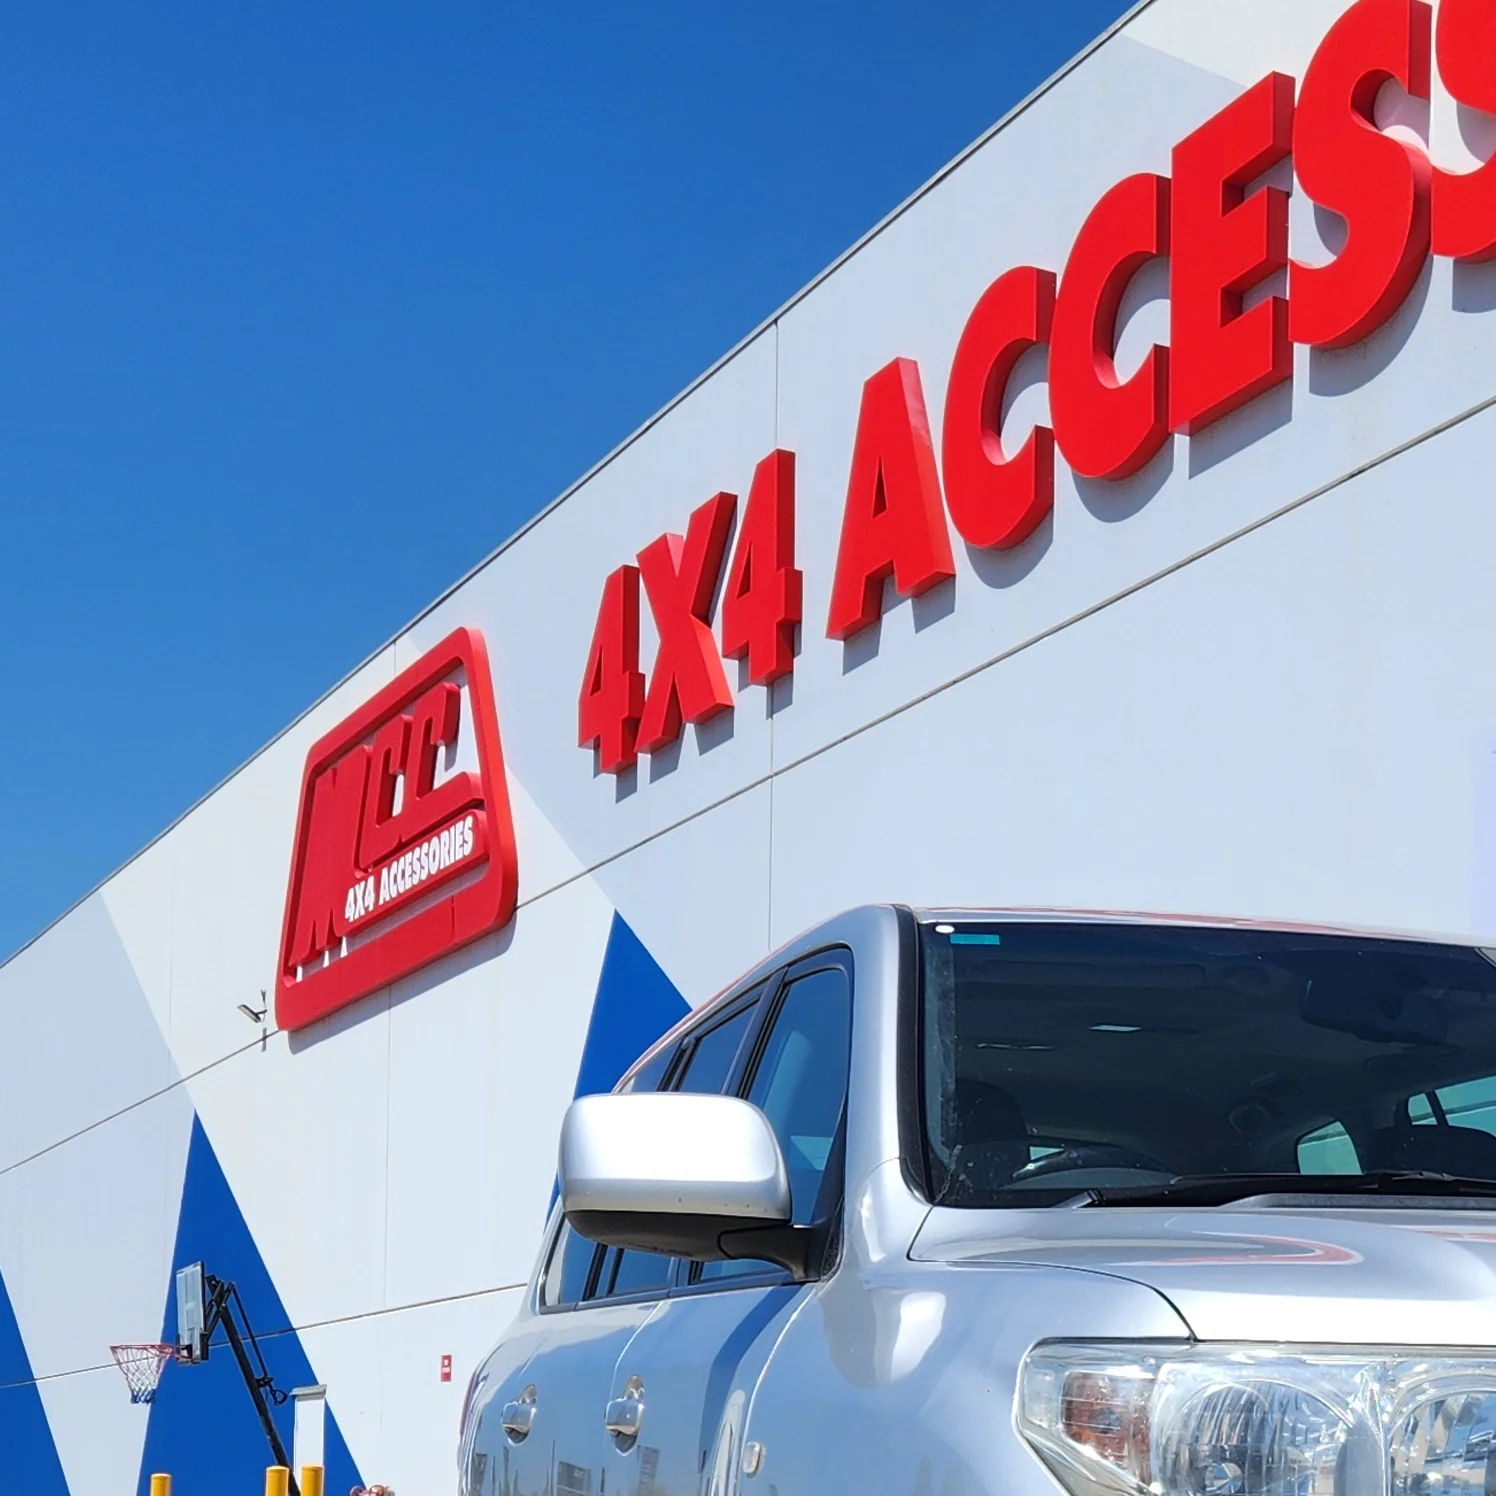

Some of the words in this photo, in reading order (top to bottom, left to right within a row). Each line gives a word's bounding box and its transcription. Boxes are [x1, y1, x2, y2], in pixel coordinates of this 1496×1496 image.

[578, 447, 803, 775] 4X4
[344, 875, 375, 923] 4X4
[378, 815, 474, 906] ACCESSORIES
